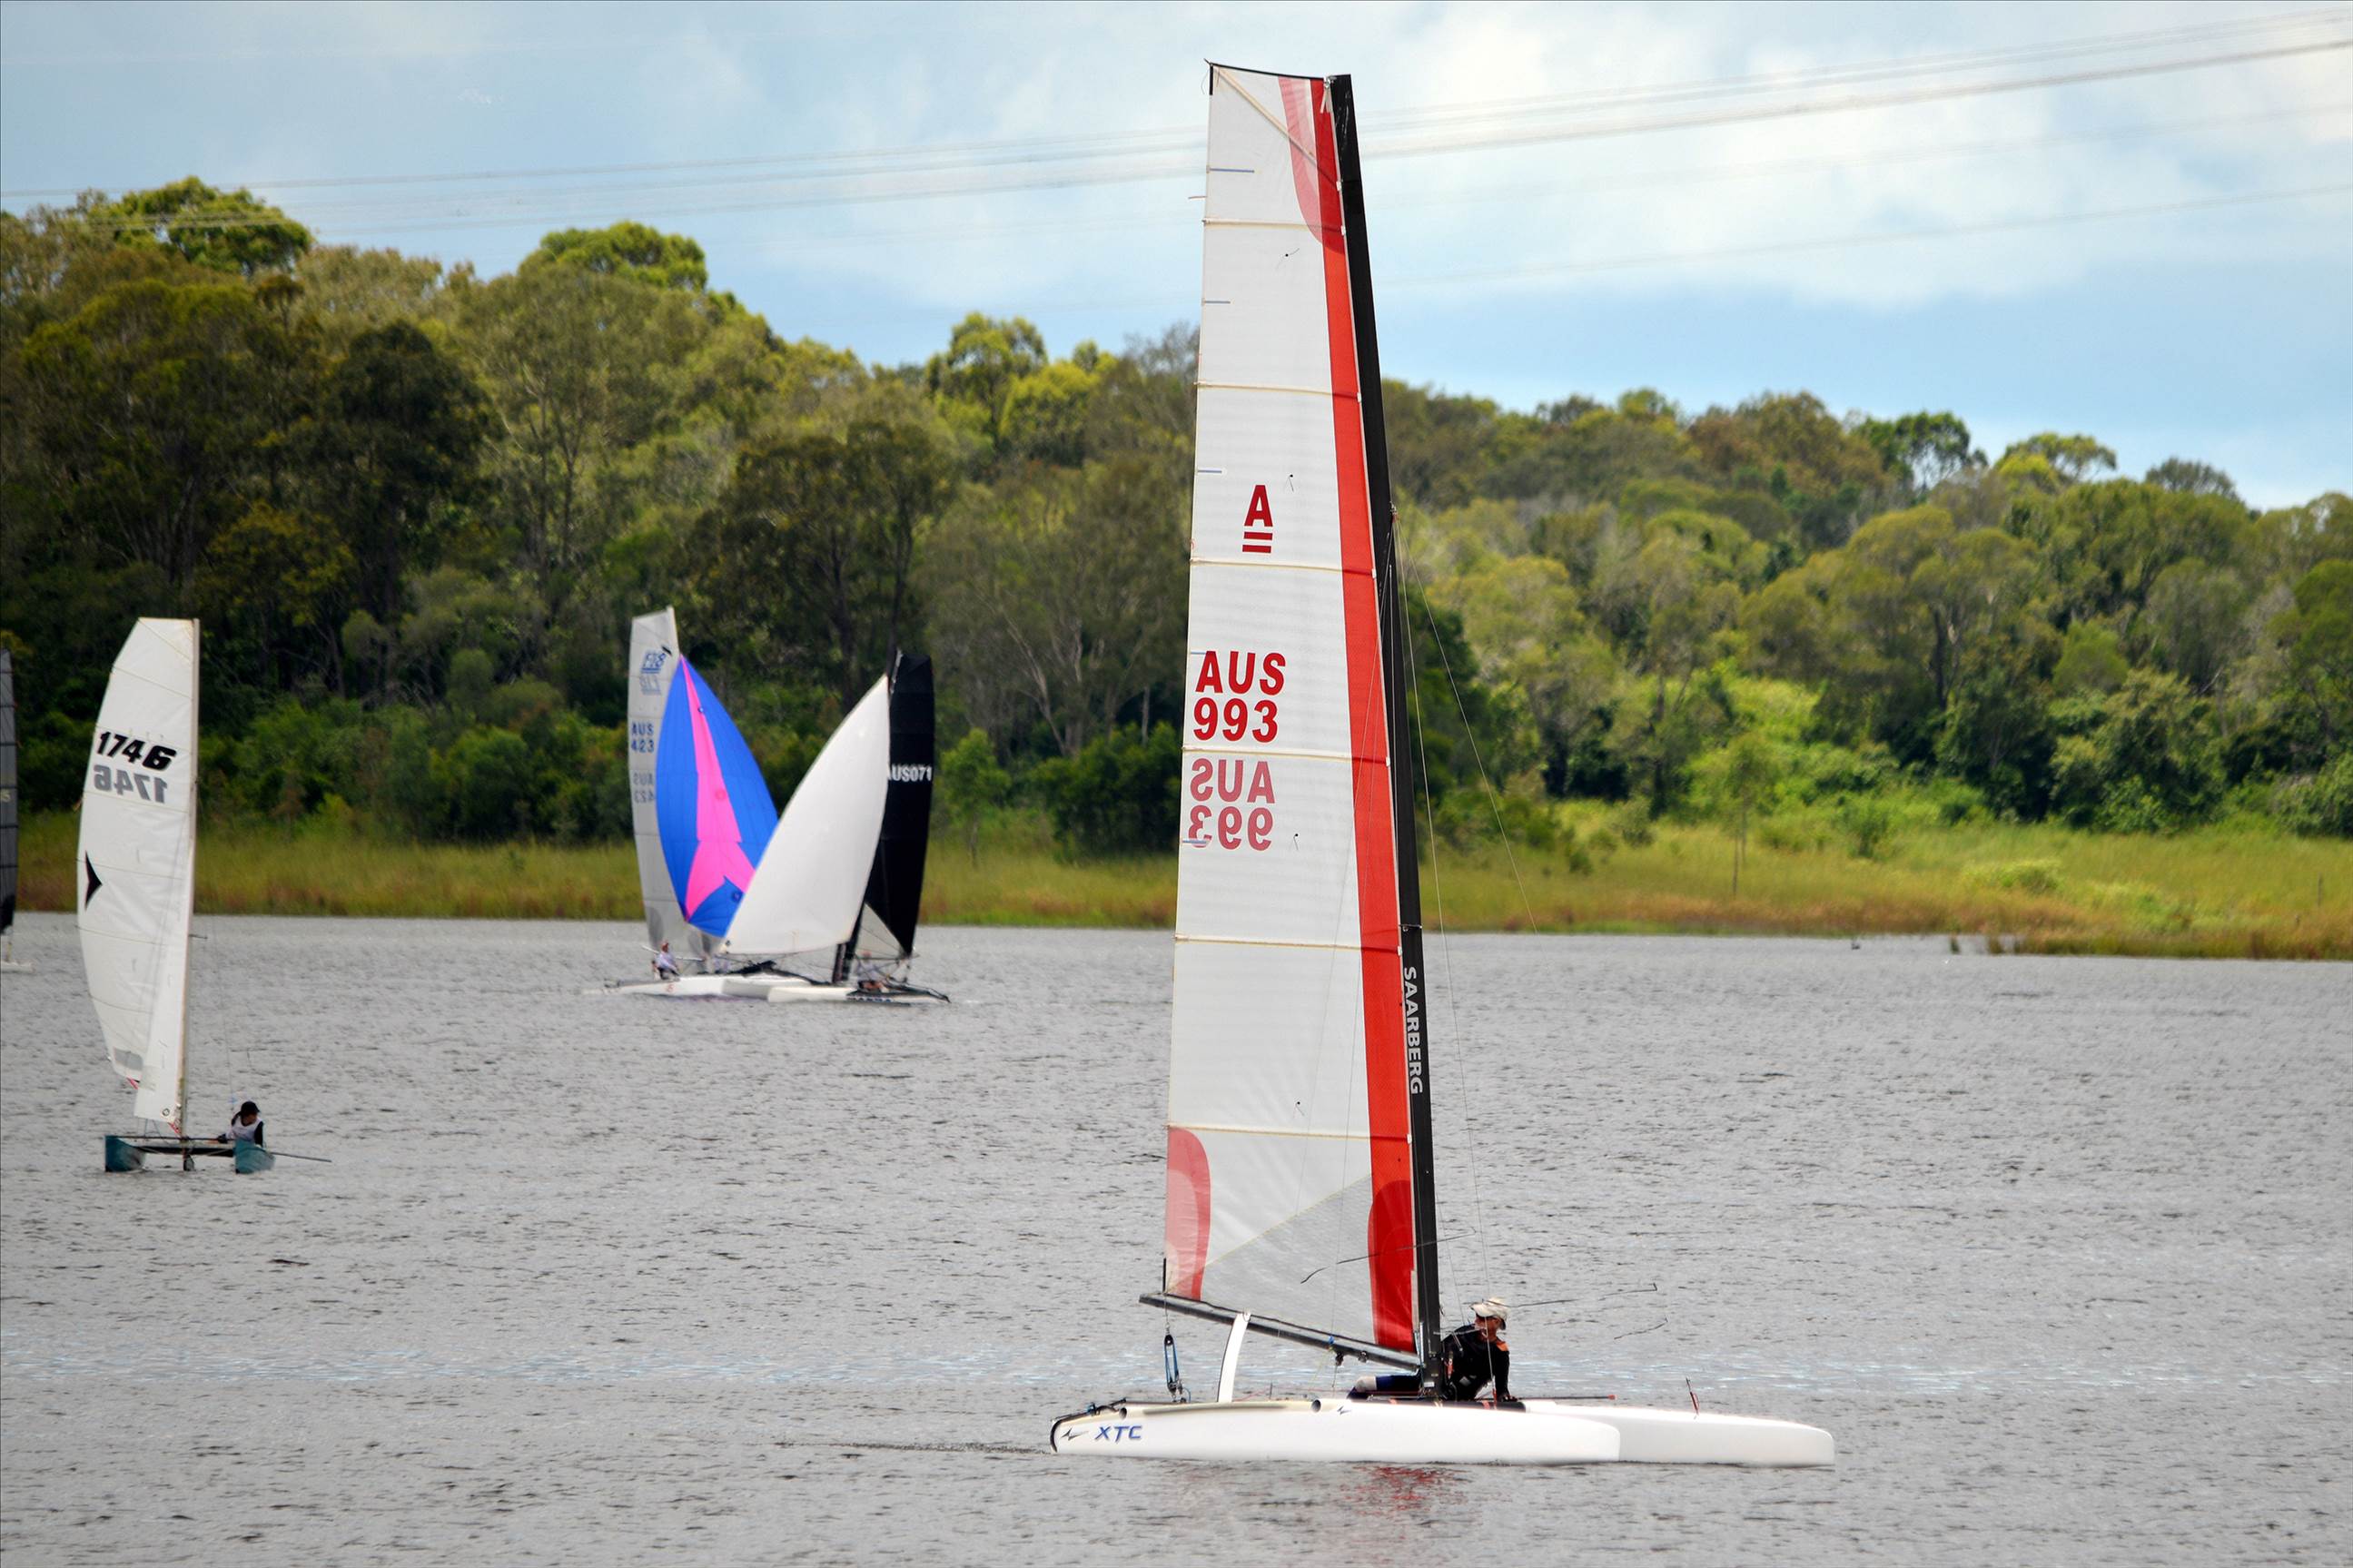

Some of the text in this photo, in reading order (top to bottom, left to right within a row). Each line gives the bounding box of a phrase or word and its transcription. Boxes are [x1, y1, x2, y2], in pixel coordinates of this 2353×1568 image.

[1243, 485, 1273, 528] A
[1195, 651, 1286, 695] AUS
[631, 722, 654, 736] AUS
[1193, 697, 1278, 743] 993
[97, 732, 176, 771] 1746
[631, 738, 654, 754] 423
[889, 764, 932, 782] US071
[1404, 966, 1423, 1094] SAARBERG
[1094, 1425, 1142, 1444] XTC
